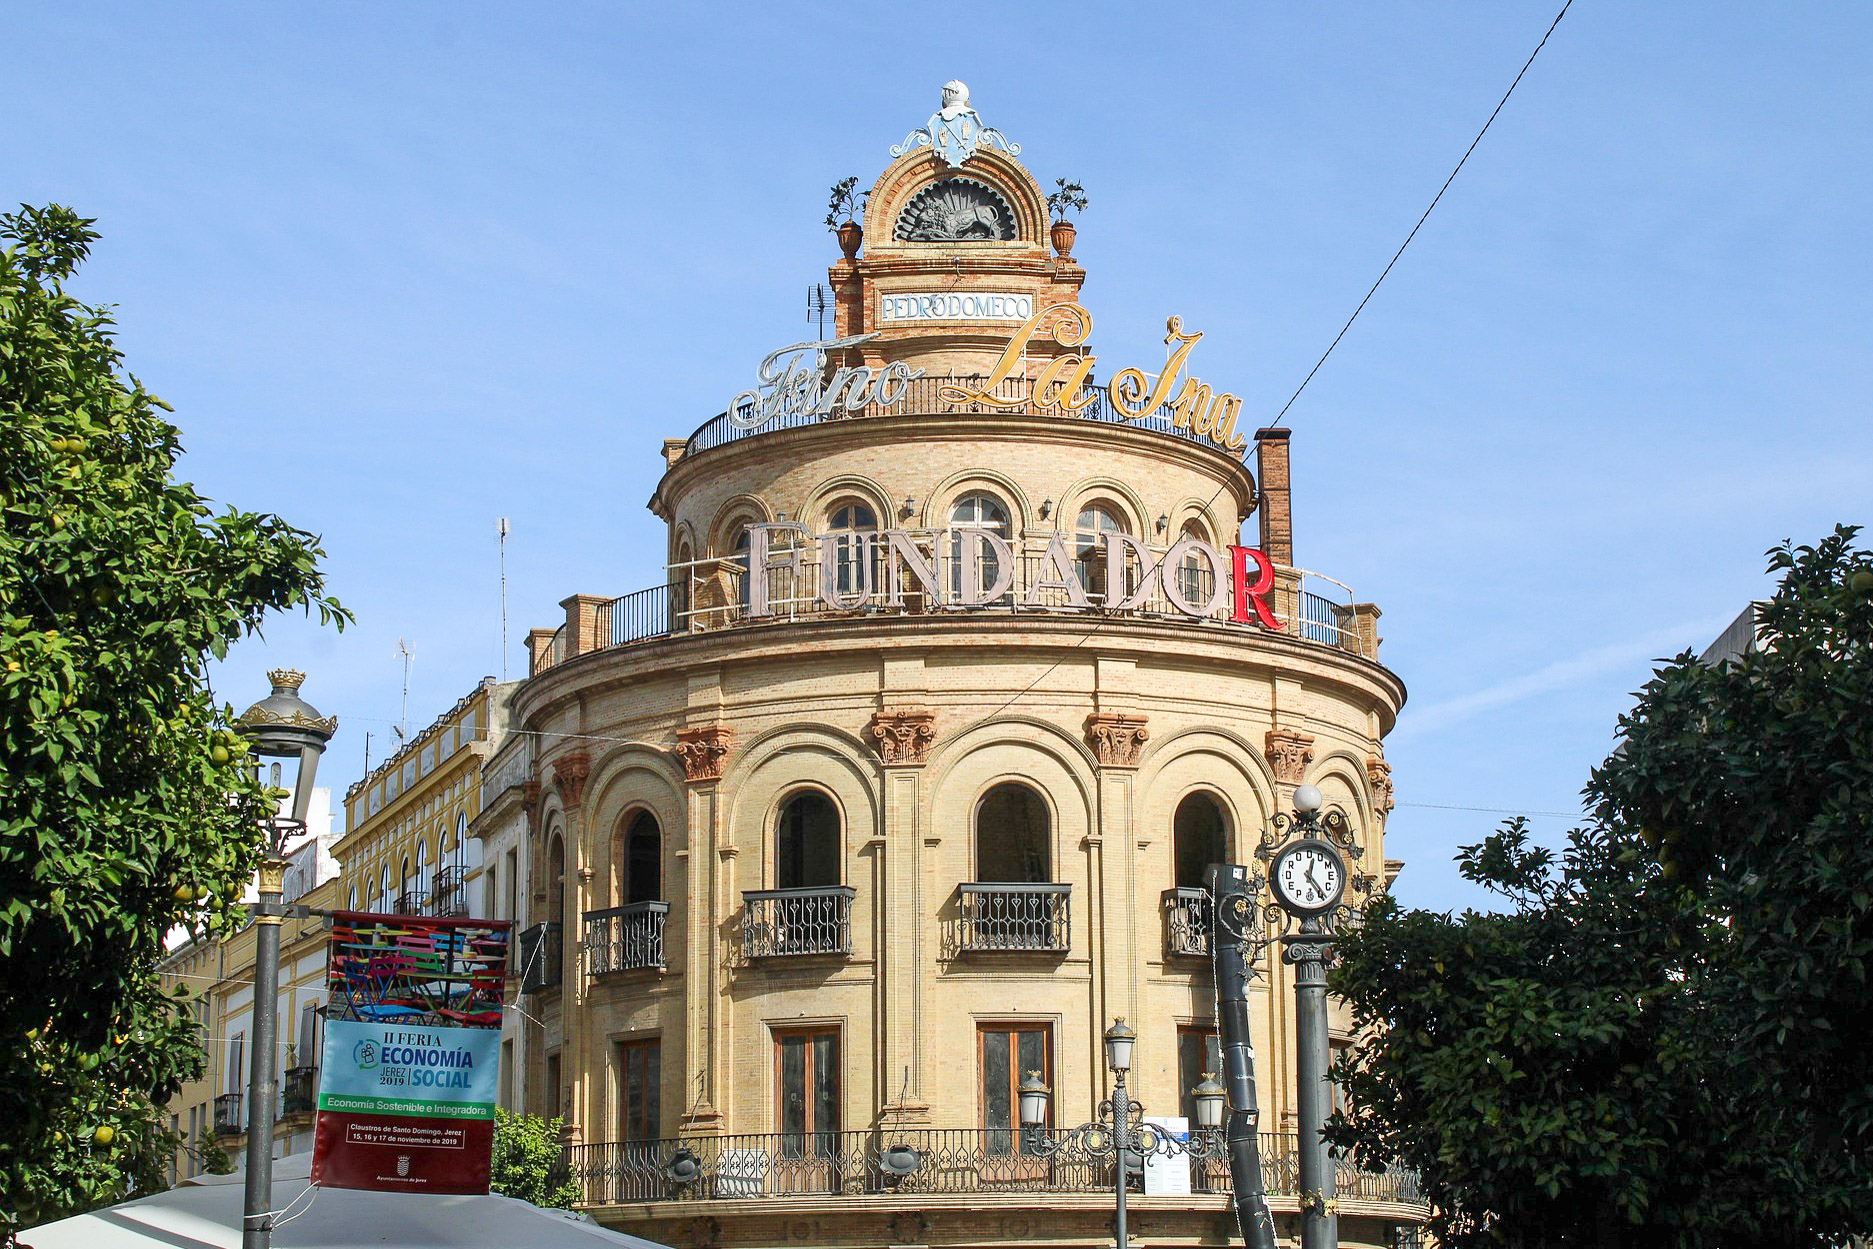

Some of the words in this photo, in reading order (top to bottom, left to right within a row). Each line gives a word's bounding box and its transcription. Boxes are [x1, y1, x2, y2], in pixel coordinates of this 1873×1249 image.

[882, 295, 947, 319] PEDRO
[949, 295, 1031, 319] DOMECQ
[727, 332, 926, 429] Fino
[937, 301, 1098, 412] La
[742, 521, 1287, 630] FUNDADOR
[384, 1031, 395, 1044] II
[398, 1032, 442, 1047] FERIA
[380, 1046, 473, 1068] ECONOMÍA
[380, 1067, 406, 1077] JEREZ
[380, 1077, 404, 1086] 2019
[411, 1069, 472, 1088] SOCIAL
[327, 1097, 374, 1109] Economía
[376, 1101, 425, 1113] Sostenible
[426, 1105, 432, 1113] e
[434, 1104, 487, 1116] Integradora
[350, 1123, 382, 1132] Claustros
[392, 1126, 411, 1134] Santo
[412, 1127, 443, 1137] Domingo,
[353, 1133, 363, 1141] 15,
[397, 1136, 431, 1144] noviembre
